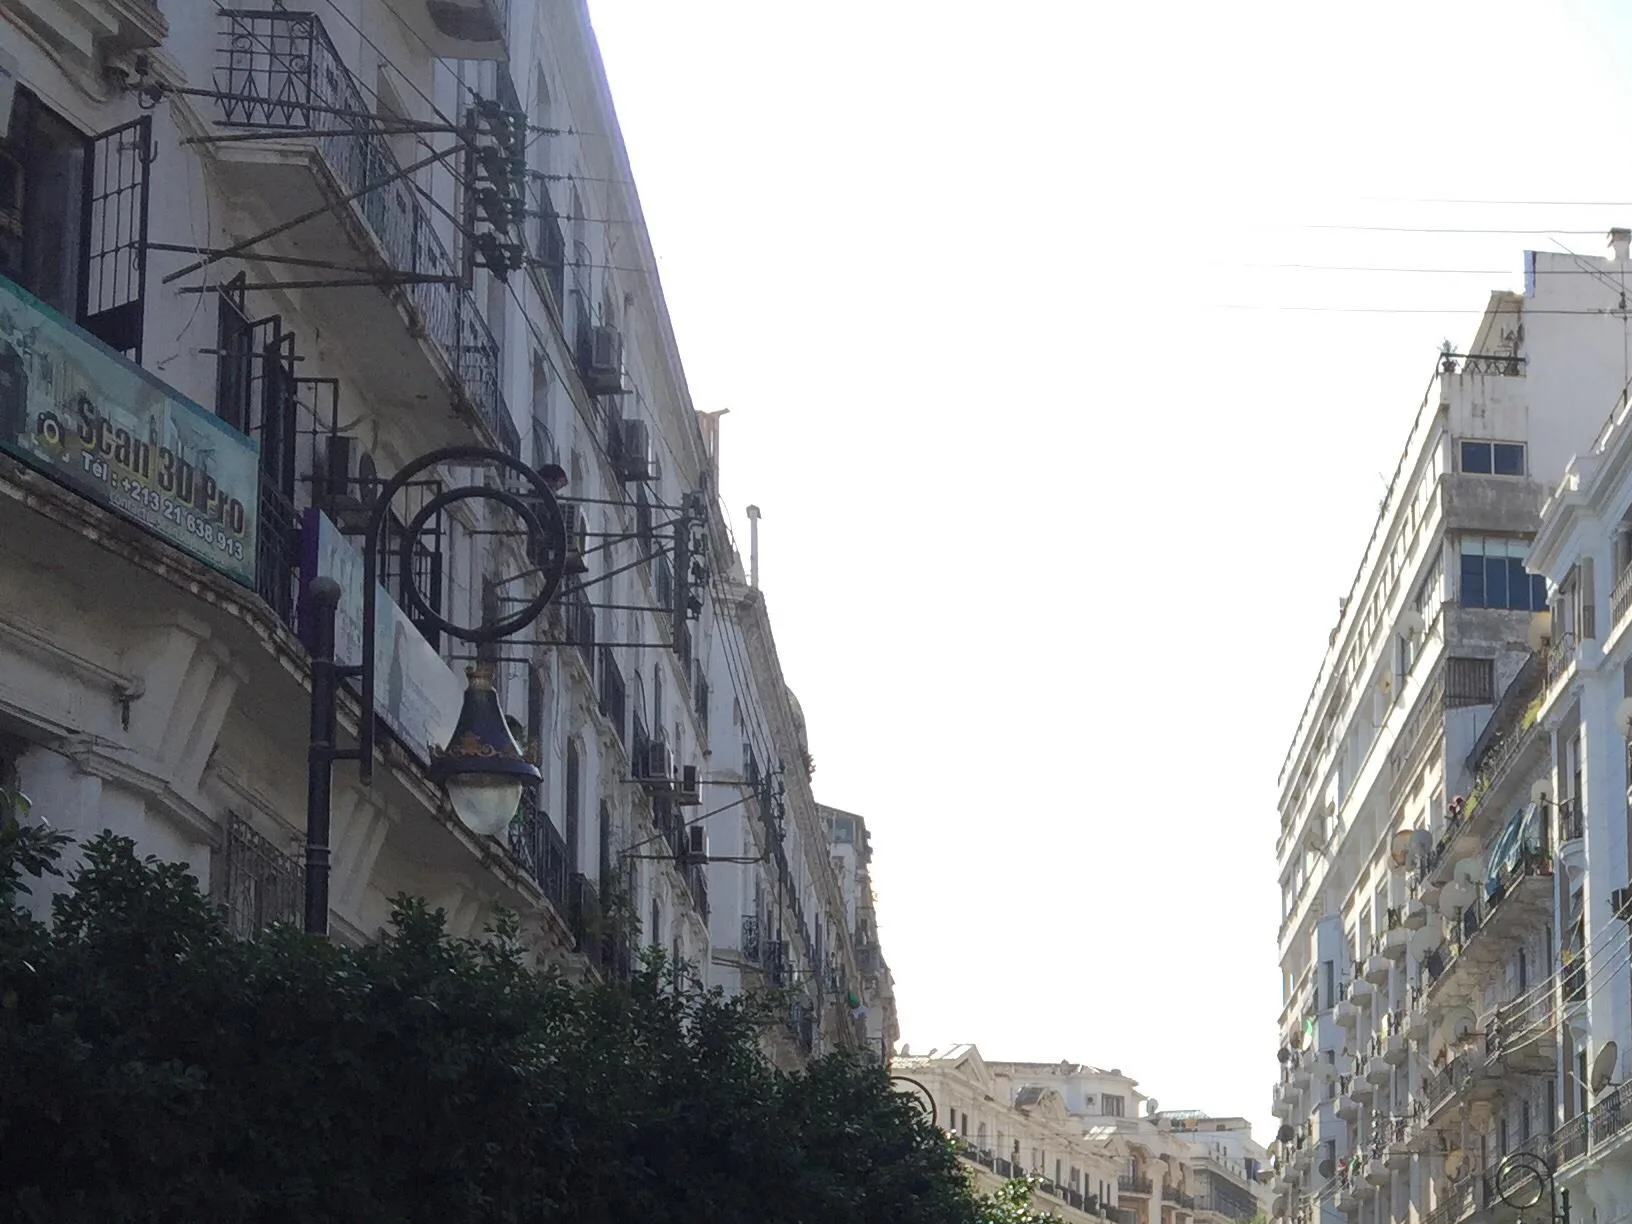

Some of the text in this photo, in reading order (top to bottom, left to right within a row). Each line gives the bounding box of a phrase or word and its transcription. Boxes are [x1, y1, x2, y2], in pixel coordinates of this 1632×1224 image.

[77, 394, 150, 479] Scan
[200, 474, 245, 538] Pro
[164, 499, 182, 525] 21
[186, 514, 213, 544] 638
[217, 532, 244, 561] 913
